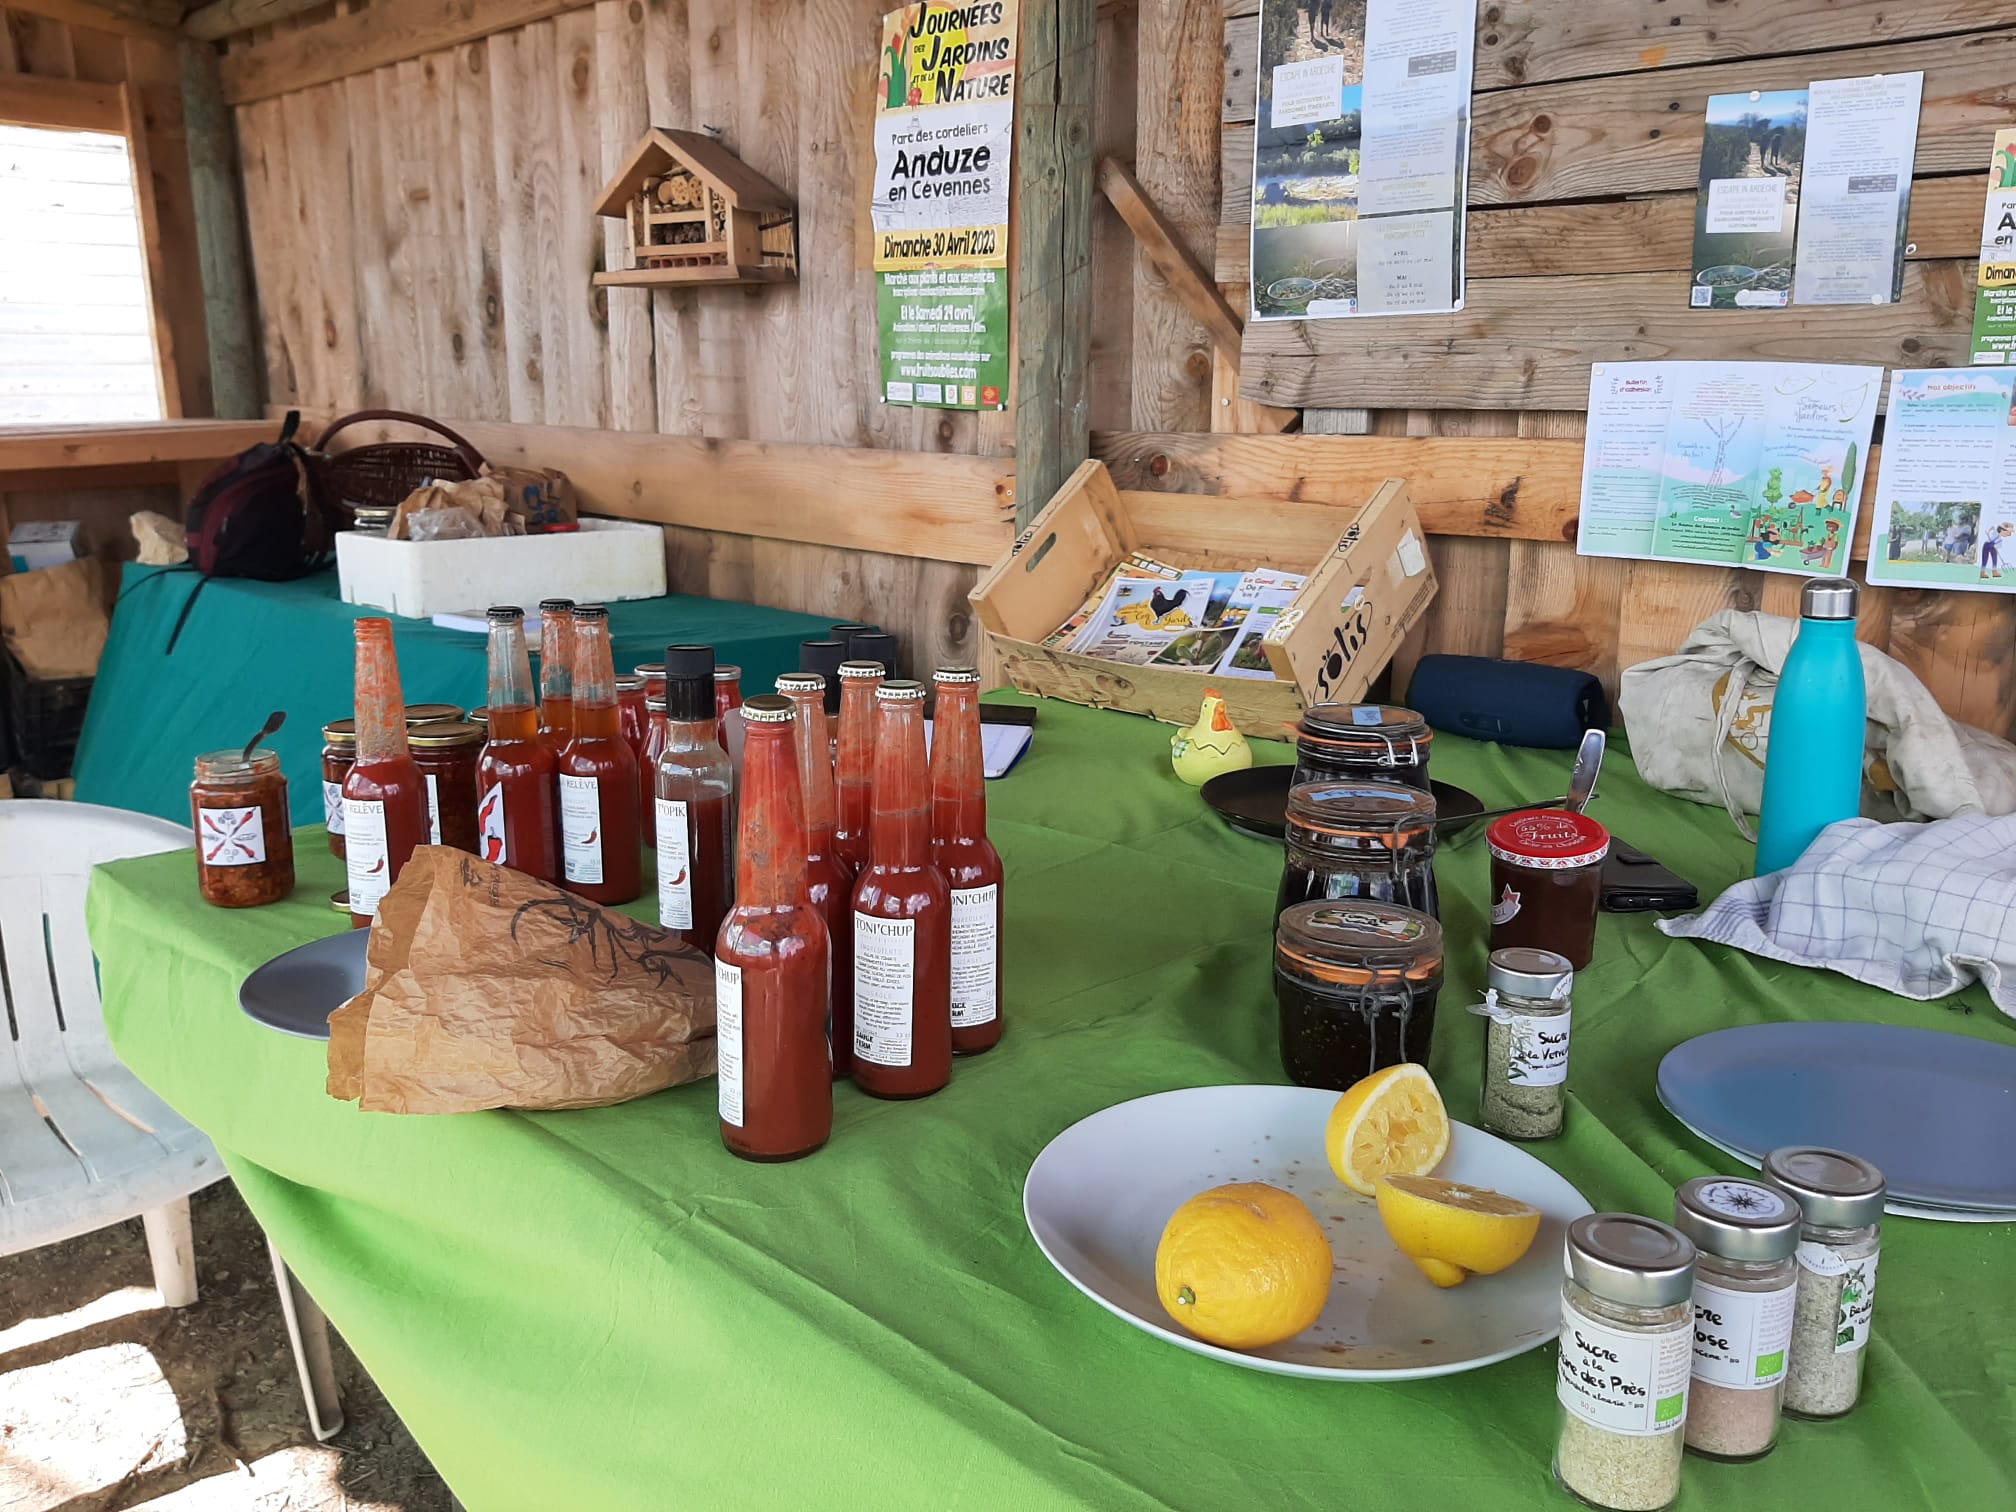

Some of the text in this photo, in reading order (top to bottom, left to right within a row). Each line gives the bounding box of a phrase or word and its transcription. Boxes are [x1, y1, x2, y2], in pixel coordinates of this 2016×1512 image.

[910, 0, 1003, 38] JOURNÉES
[921, 36, 1009, 71] JARDINS
[935, 69, 1011, 104] NATURE
[892, 122, 988, 145] Parc des cordeliers
[891, 145, 990, 180] Anduze
[889, 176, 991, 201] en Cévennes
[884, 229, 995, 258] Dimanche 30 Avril 2023
[1994, 235, 2014, 245] en
[1986, 266, 2016, 280] Diman
[856, 917, 913, 937] TONI'CHUP
[1695, 1304, 1724, 1327] cre
[1575, 1330, 1619, 1363] Sucre
[1592, 1358, 1605, 1373] la
[1580, 1369, 1607, 1389] des
